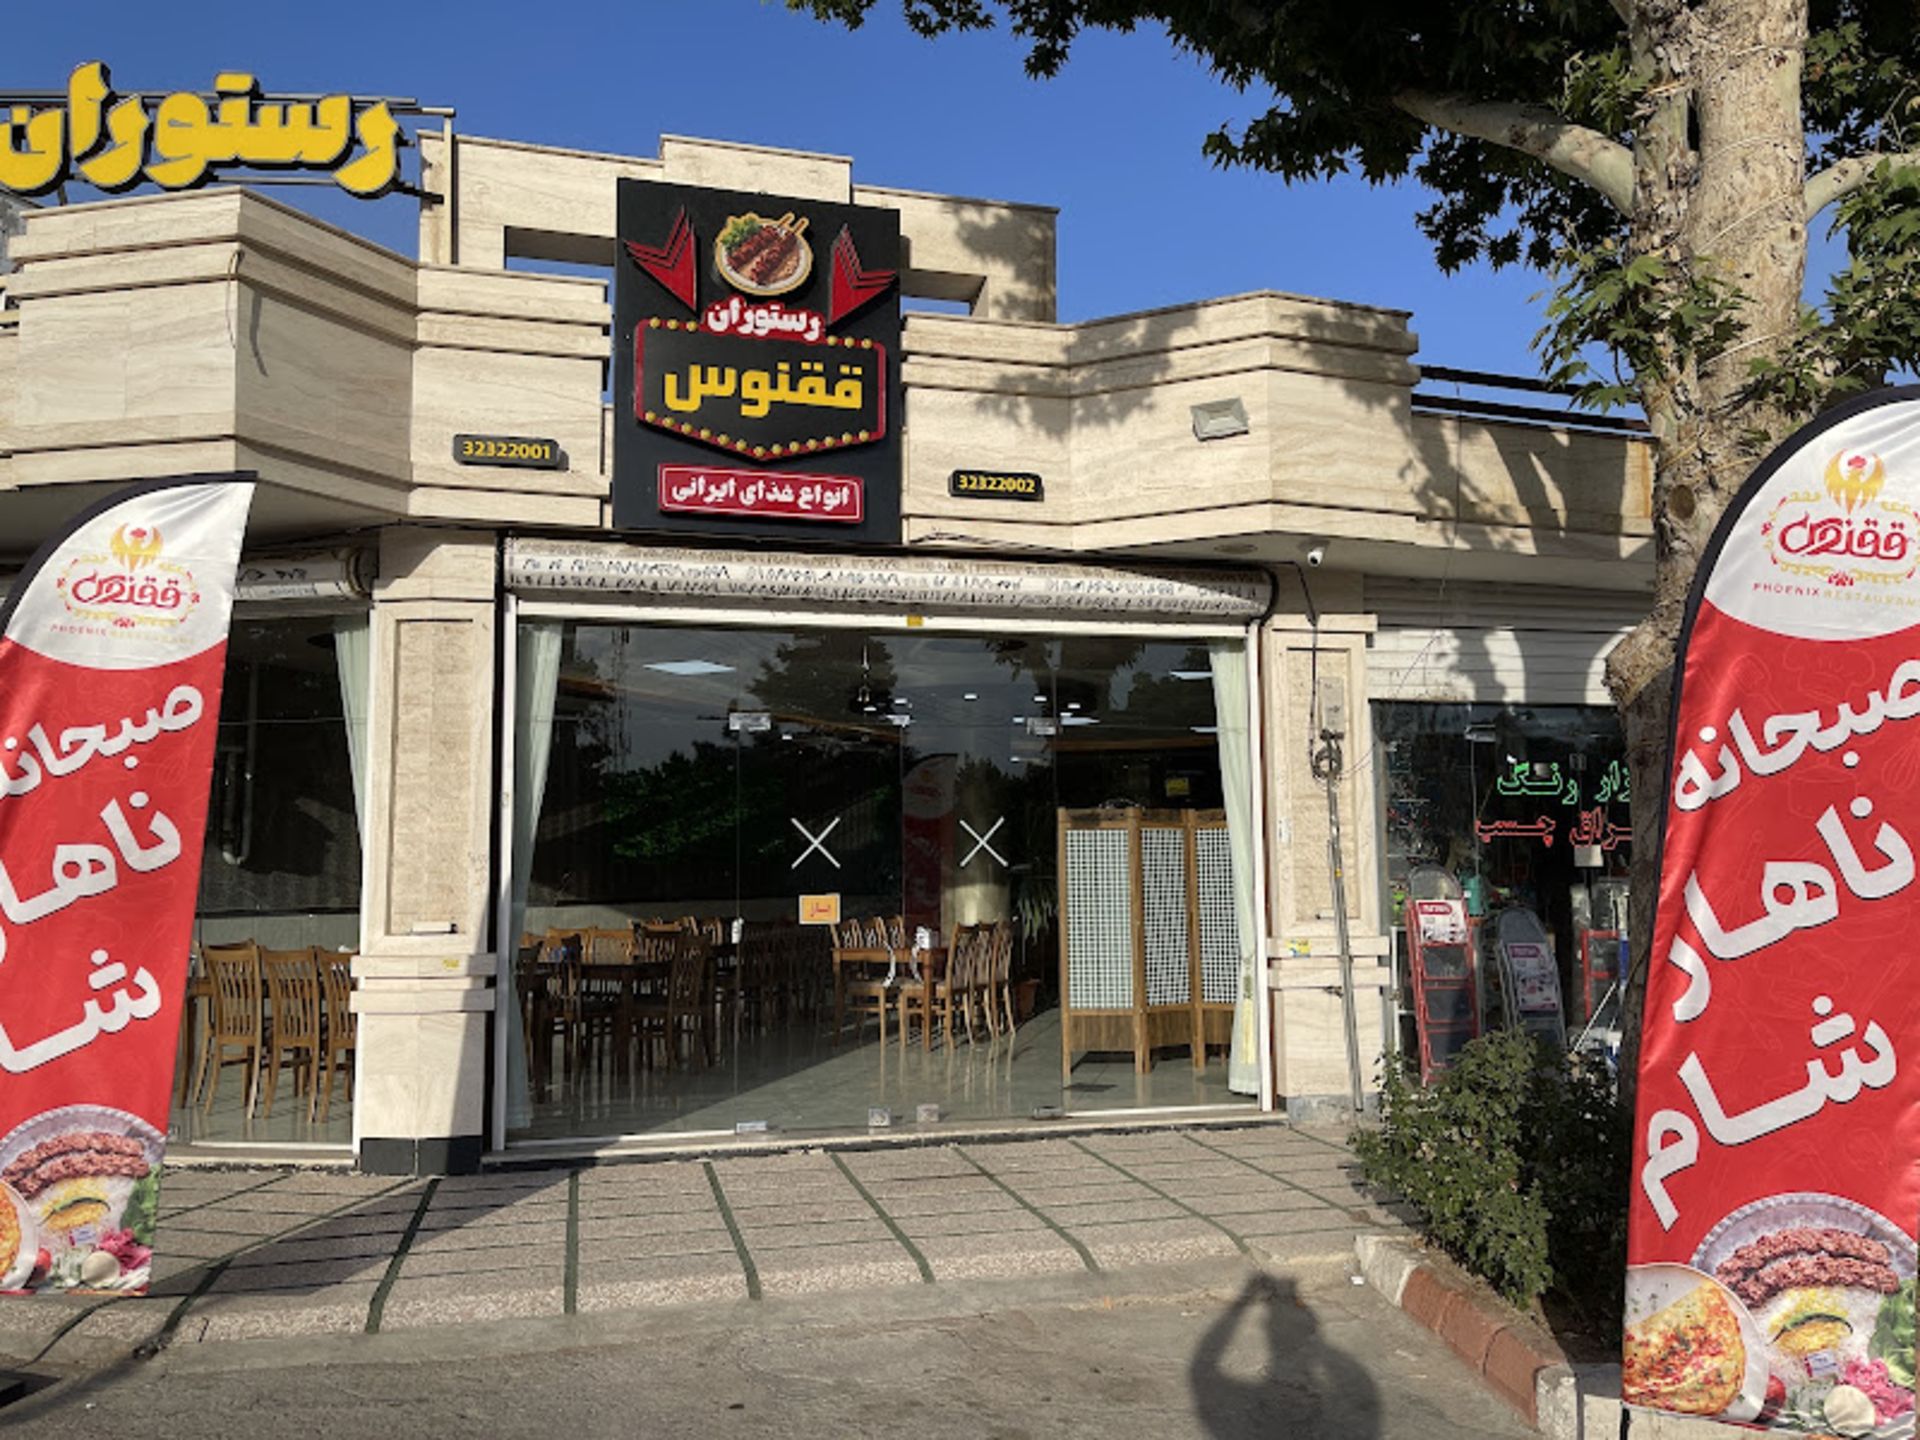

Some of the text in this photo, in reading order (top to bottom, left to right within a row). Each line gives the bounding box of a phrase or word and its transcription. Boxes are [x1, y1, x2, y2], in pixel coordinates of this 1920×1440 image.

[0, 61, 400, 195] رستوران
[707, 299, 821, 340] رستوران
[664, 362, 862, 418] ققنوس
[463, 441, 551, 459] 32322001
[959, 475, 1035, 493] 32322002
[672, 475, 850, 511] انواع غذای ایرانی
[1753, 582, 1820, 597] PHOENIX
[0, 685, 203, 800] صبحان
[1675, 660, 1920, 811] صبحانه
[1569, 806, 1632, 850] راق
[0, 791, 181, 965] ناها
[1669, 796, 1916, 1022] ناهار
[0, 949, 161, 1073] شا
[1641, 995, 1898, 1231] شام
